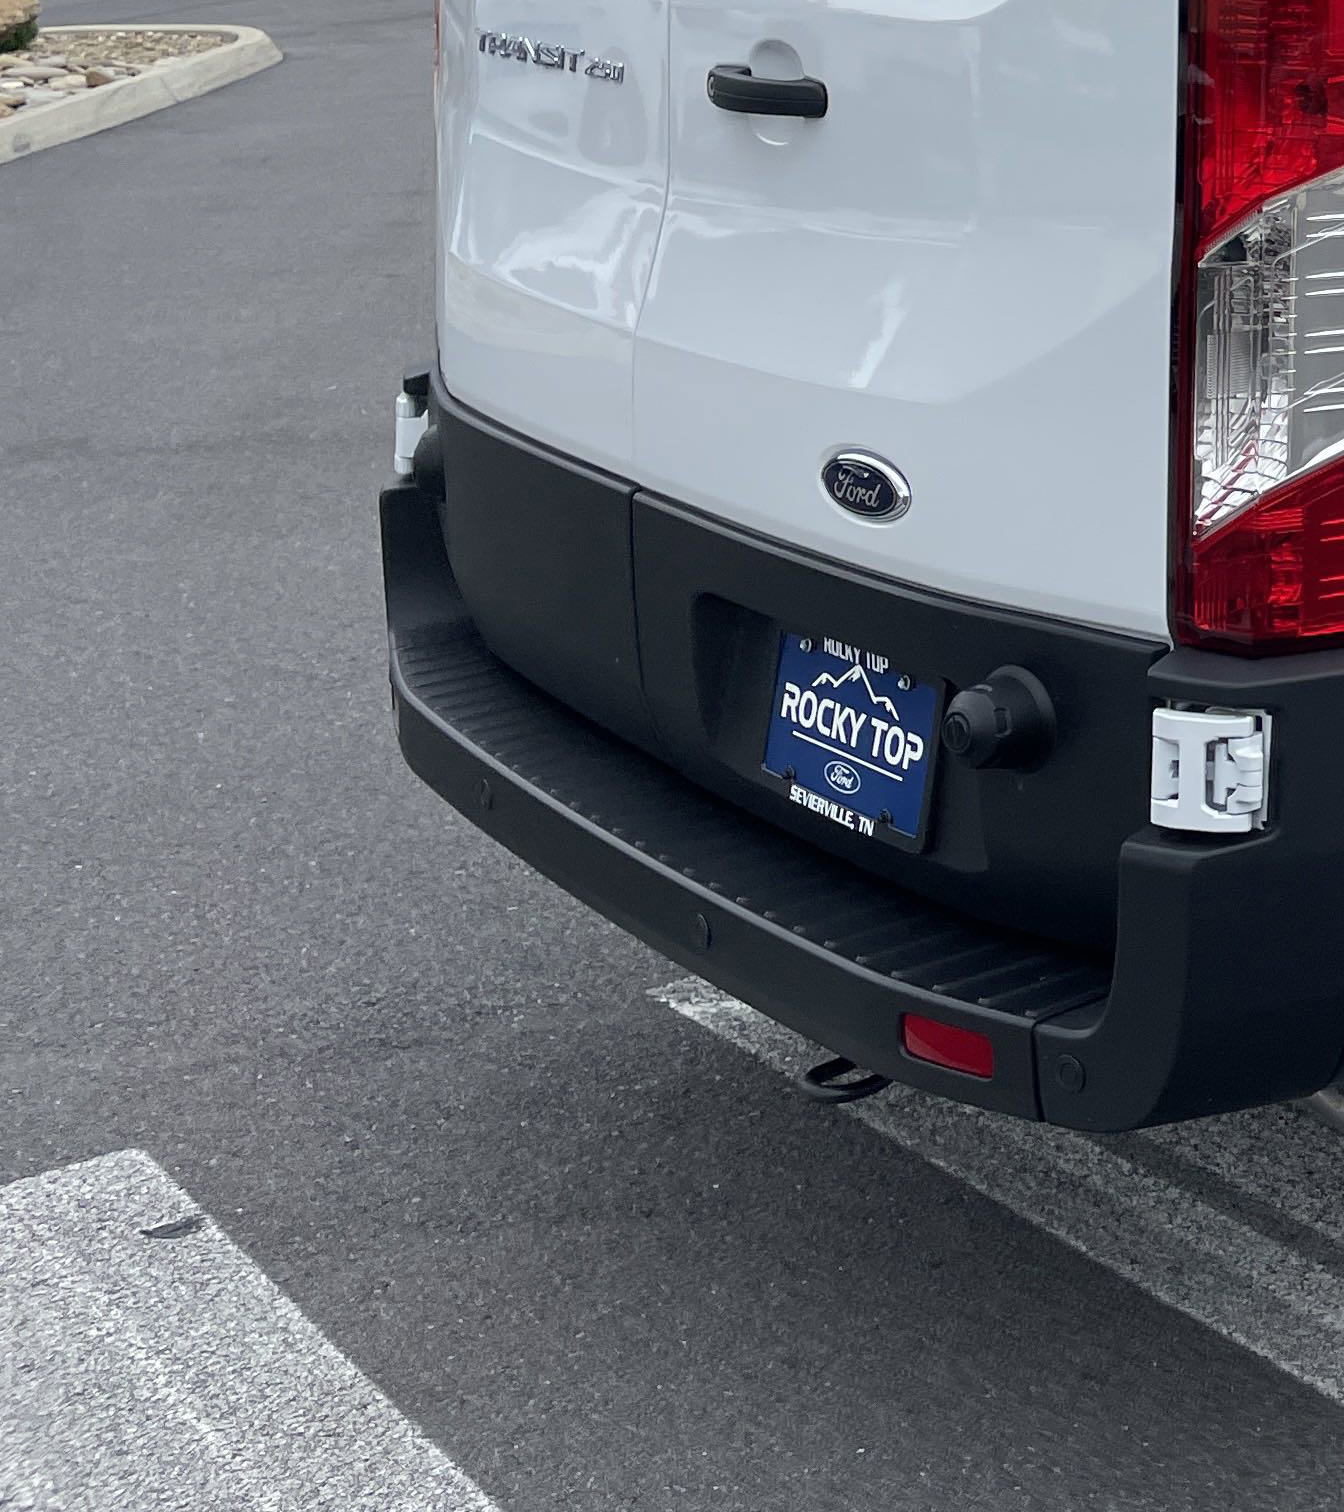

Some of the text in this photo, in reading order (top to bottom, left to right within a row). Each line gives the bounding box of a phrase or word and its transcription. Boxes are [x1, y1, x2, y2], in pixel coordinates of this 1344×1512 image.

[475, 28, 585, 72] TRANSIT
[833, 464, 882, 508] Ford
[781, 682, 924, 770] ROCKY TOP
[829, 764, 856, 789] Ford
[789, 784, 875, 837] SEVIERVILLE, TN
